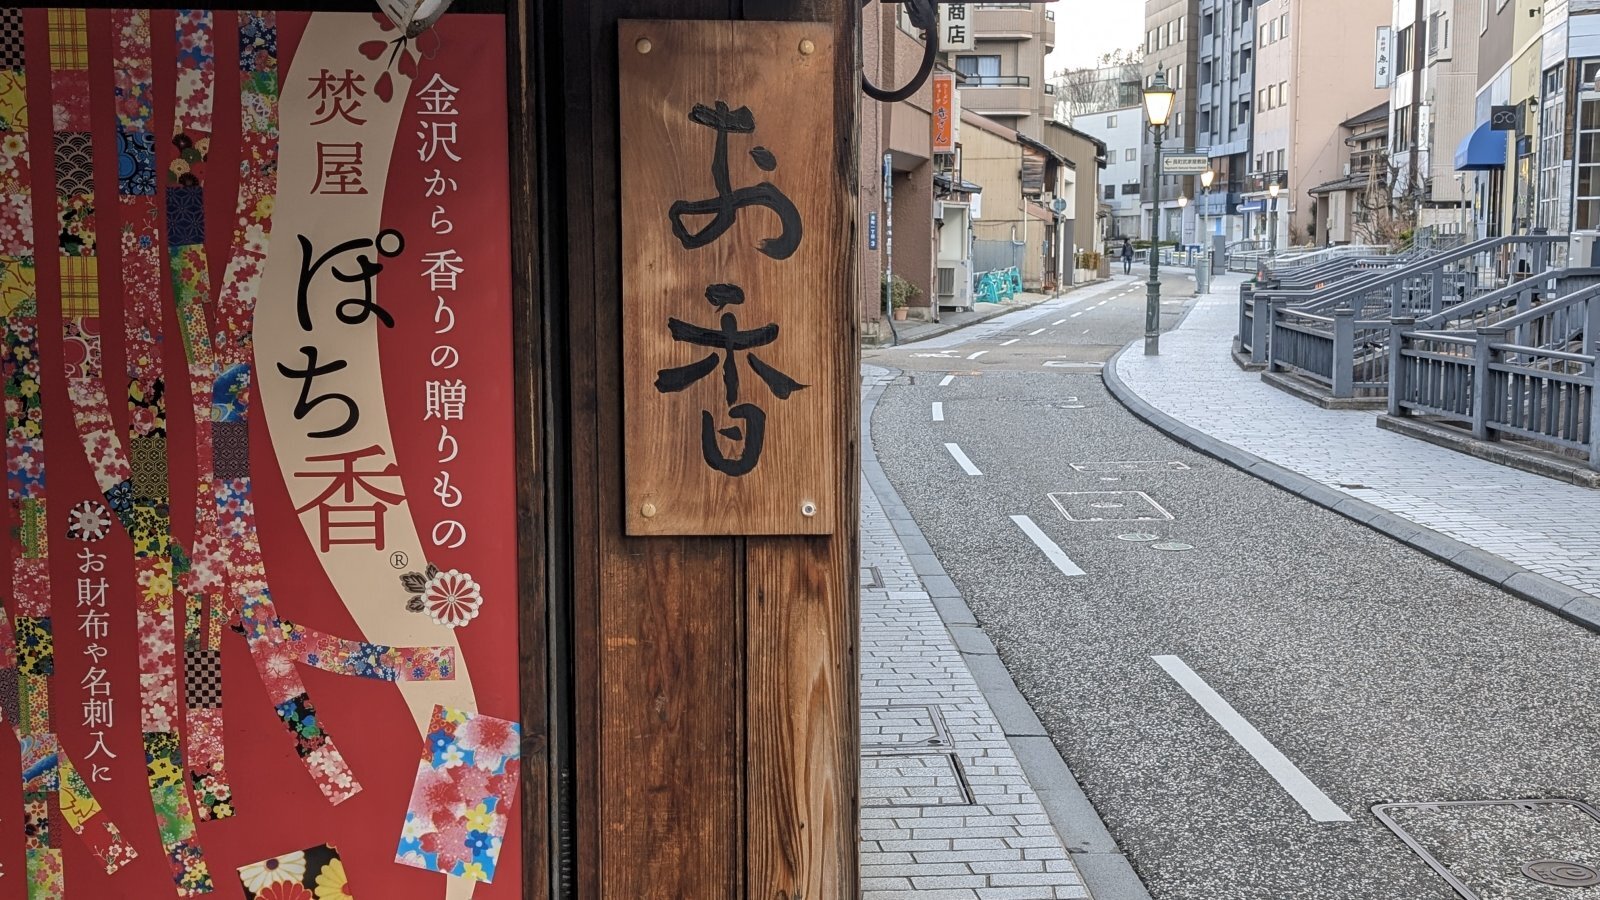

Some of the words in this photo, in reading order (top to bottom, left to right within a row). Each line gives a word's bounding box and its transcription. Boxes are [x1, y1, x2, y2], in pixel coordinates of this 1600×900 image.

[307, 68, 369, 197] 焚屋
[947, 3, 965, 44] 商店
[415, 72, 469, 550] 金沢から香りの贈りもの
[653, 99, 812, 478] お香
[77, 546, 117, 784] お財布や名刺入に
